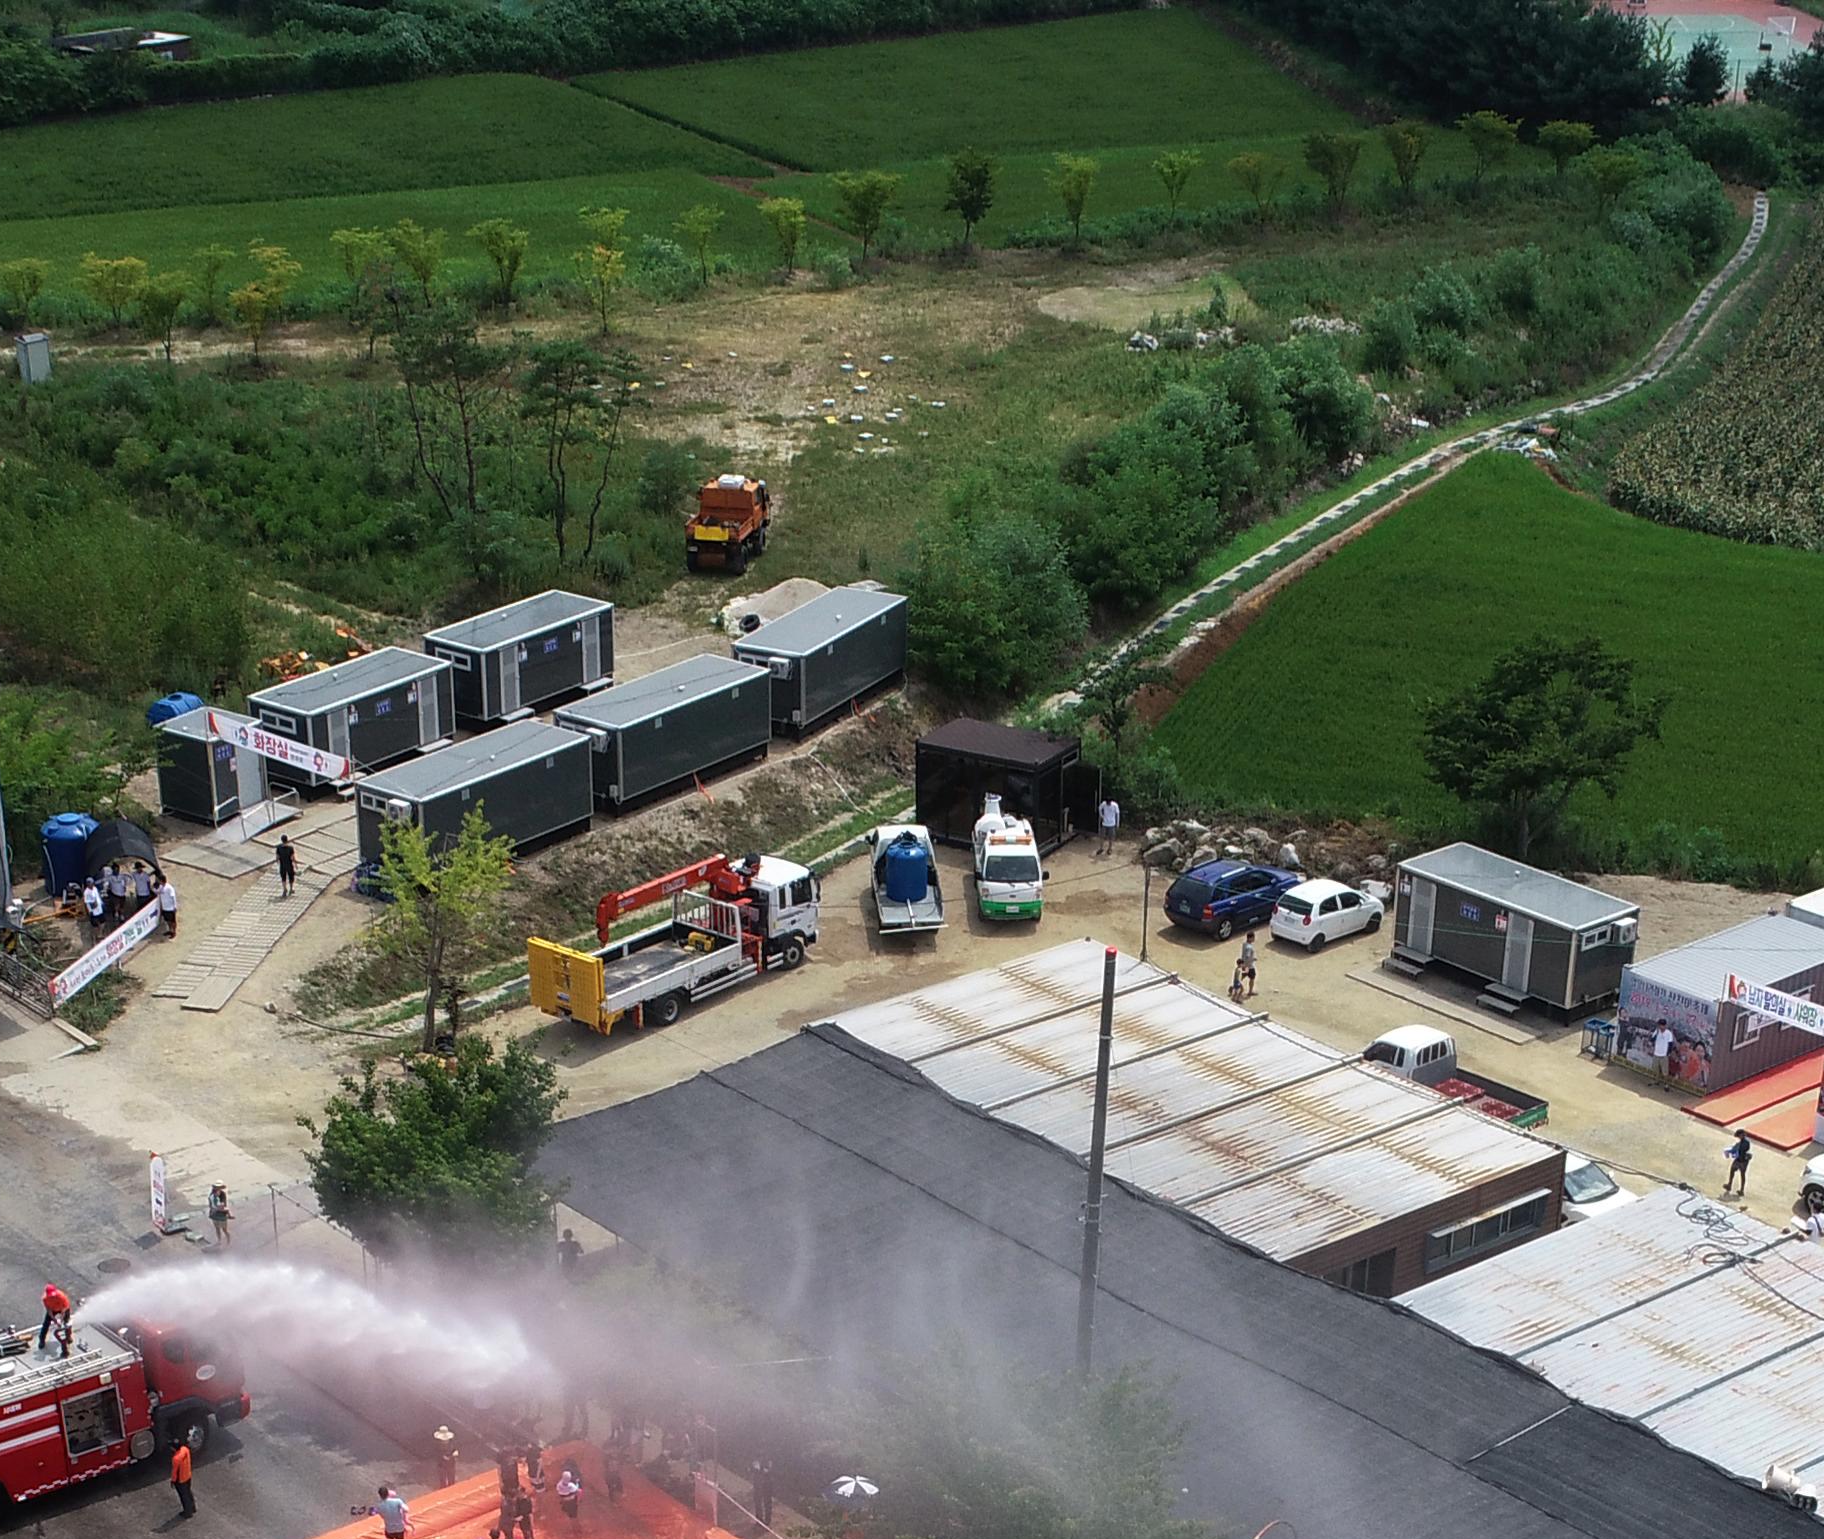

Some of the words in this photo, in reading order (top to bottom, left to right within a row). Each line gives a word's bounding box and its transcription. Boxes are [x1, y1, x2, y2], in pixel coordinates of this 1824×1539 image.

[253, 730, 289, 761] 화장실
[1748, 985, 1764, 1009] 남자
[1764, 991, 1787, 1017] 탈의실
[1795, 1002, 1818, 1028] 샤워장
